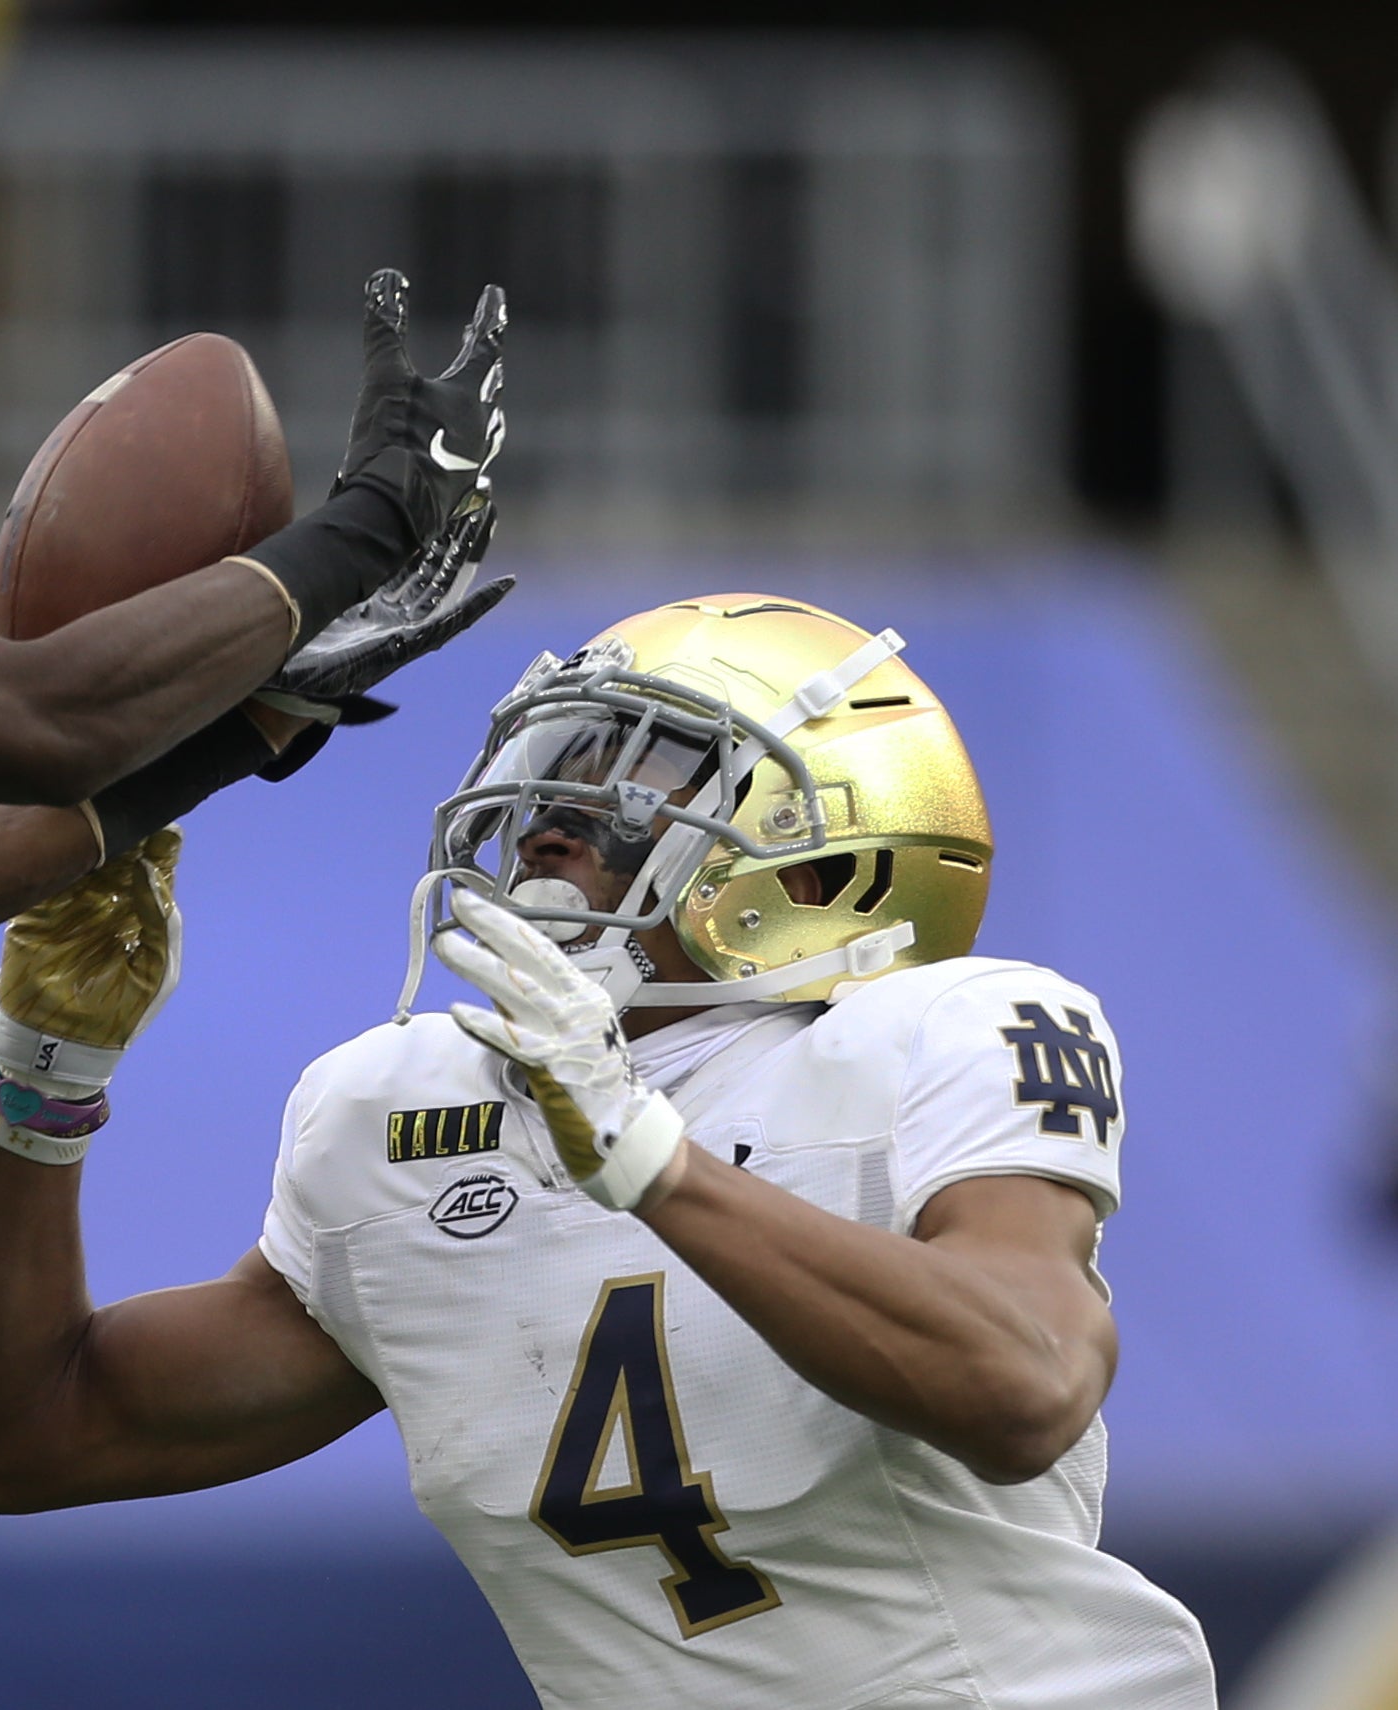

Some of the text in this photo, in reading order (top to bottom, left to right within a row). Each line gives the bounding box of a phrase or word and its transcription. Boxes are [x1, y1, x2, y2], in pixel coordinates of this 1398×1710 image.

[35, 1041, 59, 1071] UA
[442, 1187, 505, 1214] ACC
[529, 1271, 783, 1640] 4
